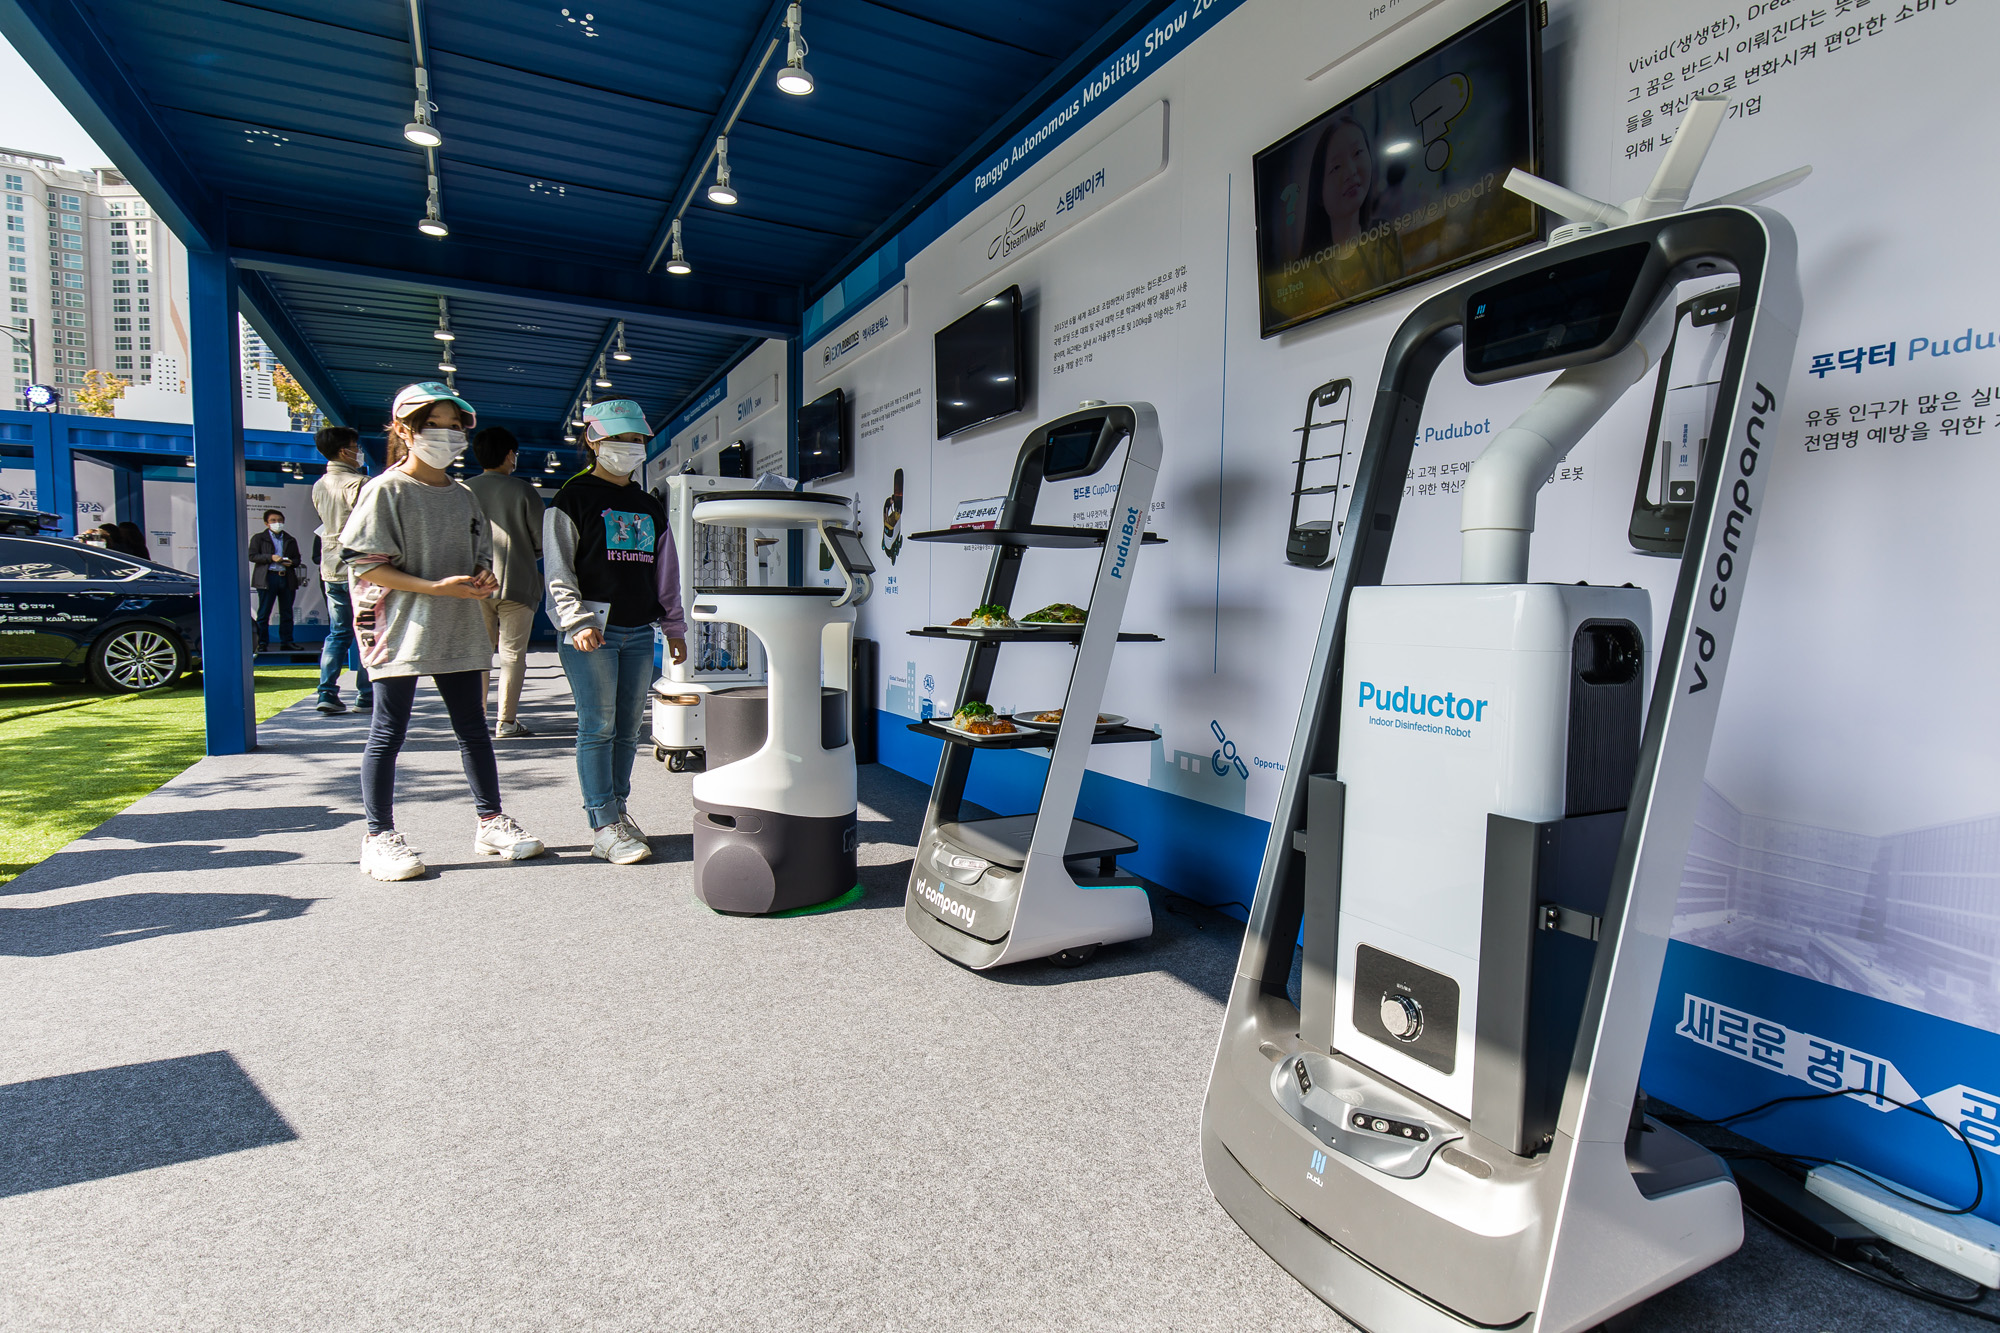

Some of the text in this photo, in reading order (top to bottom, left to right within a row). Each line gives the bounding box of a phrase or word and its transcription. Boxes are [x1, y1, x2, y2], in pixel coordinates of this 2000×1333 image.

[1627, 86, 1641, 102] 그
[1646, 72, 1676, 97] 꿈은
[1681, 47, 1730, 82] 반드시
[1736, 10, 1827, 53] 이뤄진다는
[1629, 14, 1740, 74] Vivid(생생한),
[1625, 109, 1655, 134] 들을
[1744, 42, 1816, 86] 변화시켜
[1824, 14, 1887, 53] 편안한
[974, 156, 1009, 194] Pangyo
[1010, 97, 1080, 165] Autonomous
[1082, 50, 1140, 108] Mobility
[1144, 10, 1188, 57] Show
[1624, 136, 1654, 160] 위해
[1728, 94, 1762, 120] 기업
[1056, 168, 1105, 215] 스팀메이커
[1005, 220, 1046, 254] SteamMaker
[1283, 256, 1312, 278] How
[1314, 242, 1341, 264] can
[1345, 218, 1390, 250] robots
[1394, 196, 1439, 232] serve
[1808, 328, 2000, 379] 푸닥터 Pudu
[1425, 418, 1490, 442] Pudubot
[1804, 408, 1842, 428] 유동
[1848, 398, 1909, 423] 인구가
[1918, 391, 1962, 415] 많은
[1804, 430, 1859, 452] 전염병
[1866, 421, 1930, 444] 예방을
[1939, 416, 1986, 436] 위한
[1073, 486, 1090, 500] 컵드론
[1418, 466, 1437, 478] 고객
[1418, 483, 1437, 496] 위한
[1560, 466, 1584, 481] 로봇
[607, 550, 621, 561] It's
[1111, 506, 1139, 580] PuduBot
[1688, 382, 1776, 694] vd company
[1359, 681, 1488, 722] Puductor
[1369, 716, 1471, 738] Indoor Disinfection Robot
[1254, 756, 1285, 772] Opportu
[926, 886, 976, 928] company
[1680, 998, 1787, 1070] 새로운
